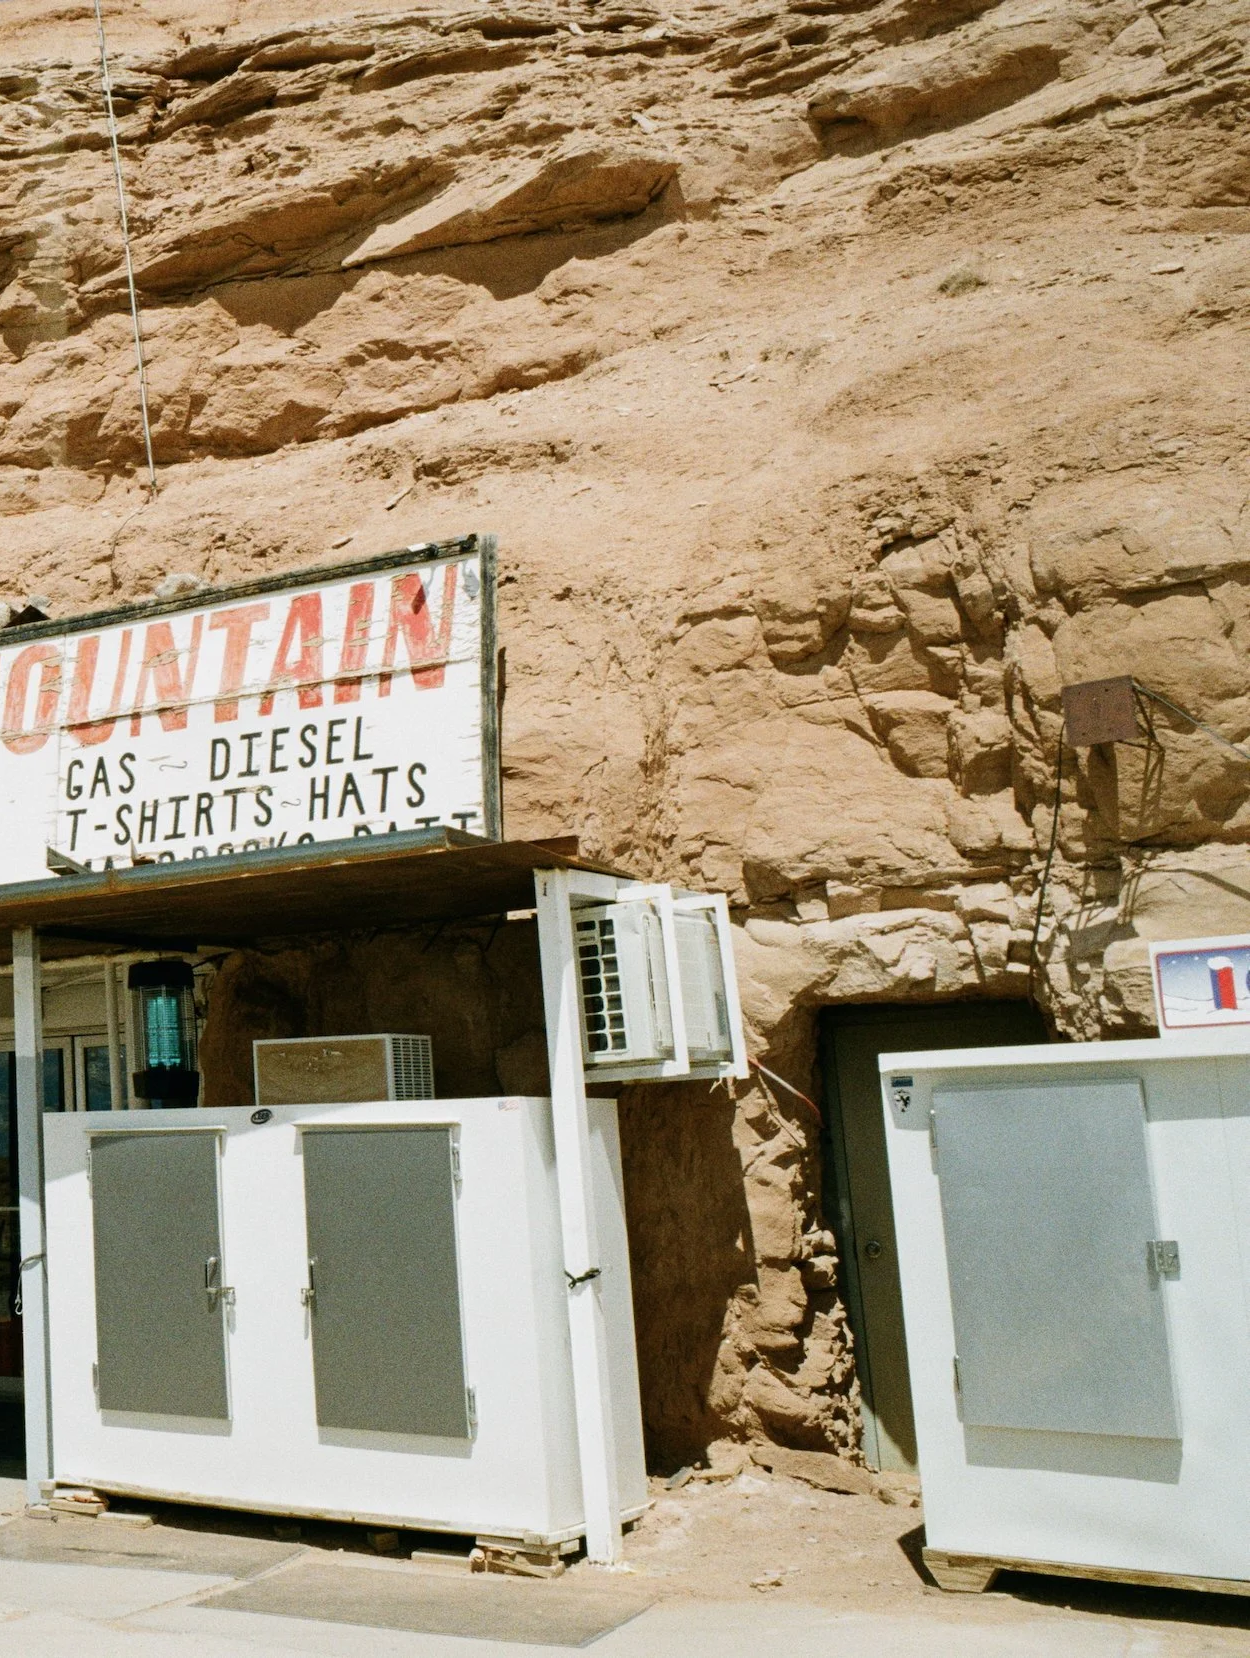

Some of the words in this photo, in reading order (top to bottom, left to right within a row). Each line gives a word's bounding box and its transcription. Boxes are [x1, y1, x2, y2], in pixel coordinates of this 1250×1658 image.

[66, 752, 136, 800] GAS
[209, 716, 374, 782] DIESEL
[66, 784, 274, 851] T-SHIRTS
[308, 762, 427, 821] HATS
